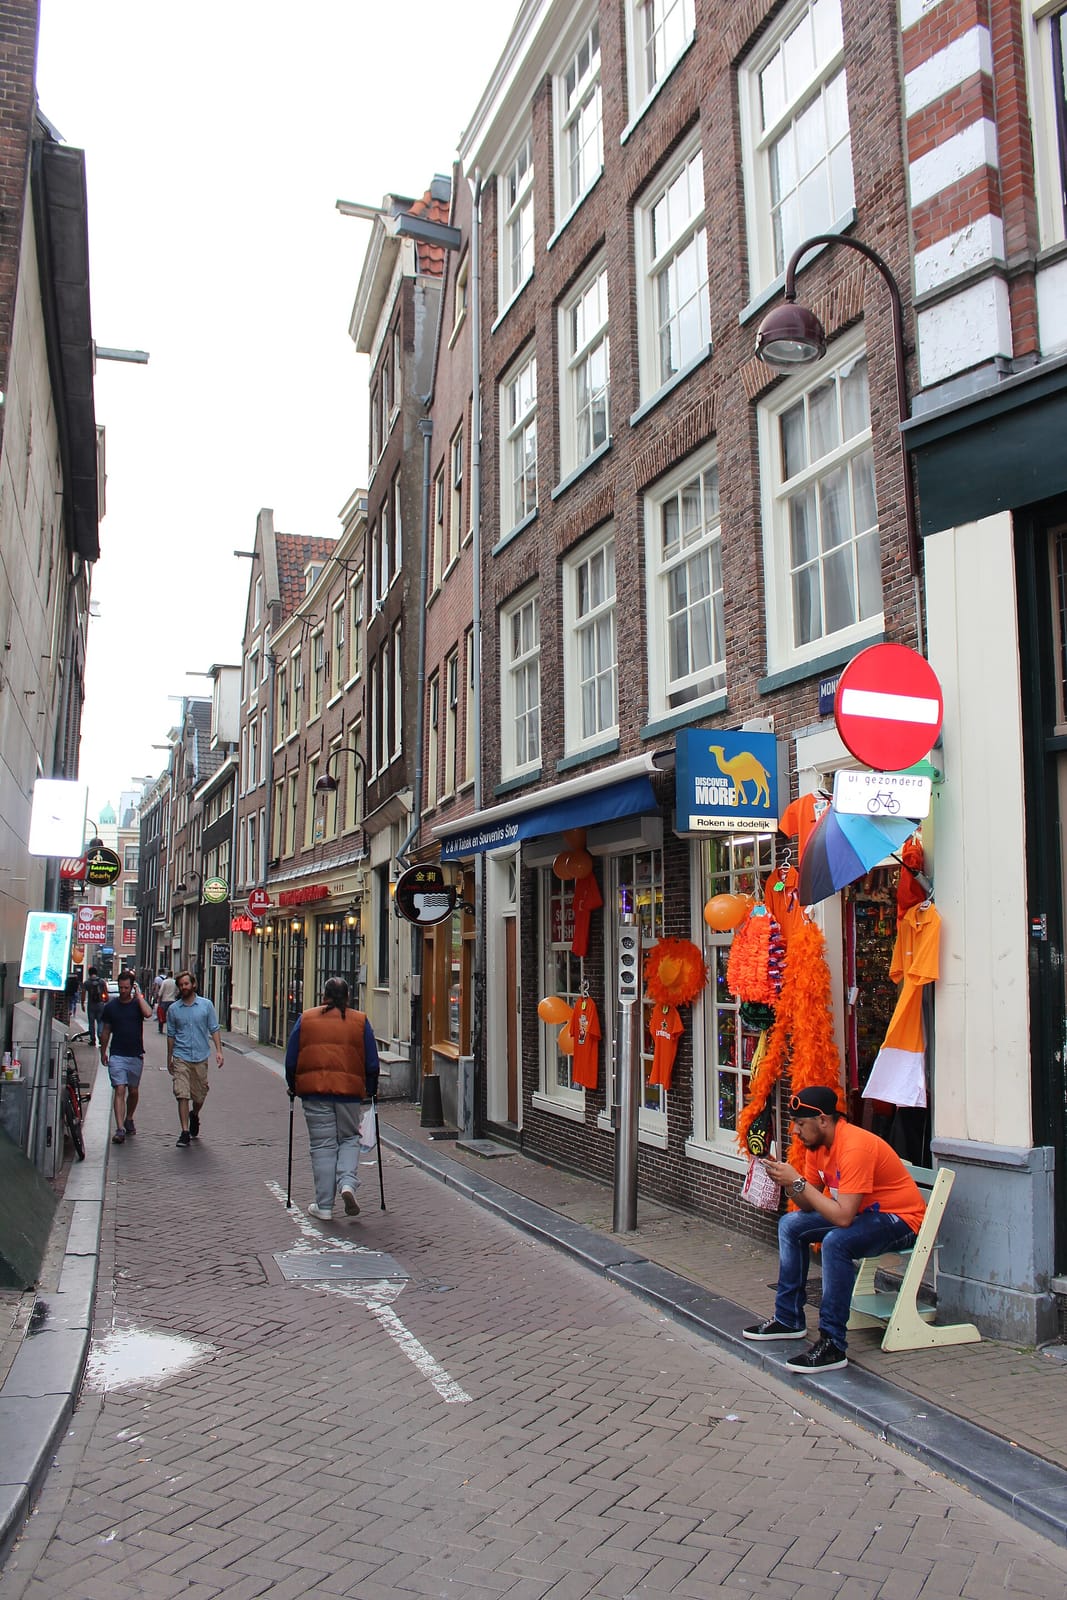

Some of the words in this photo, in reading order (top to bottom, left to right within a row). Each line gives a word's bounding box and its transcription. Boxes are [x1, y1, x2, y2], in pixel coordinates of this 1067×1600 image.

[695, 777, 728, 787] DISCOVER
[695, 786, 737, 806] MORE
[697, 819, 725, 827] Roken
[737, 820, 770, 830] dodelijk
[459, 836, 472, 850] Tabak
[472, 836, 479, 848] en
[479, 827, 504, 846] Souvenirs
[505, 823, 519, 839] Shop
[254, 892, 265, 902] H
[79, 923, 105, 931] Döner
[79, 931, 105, 939] Kebab
